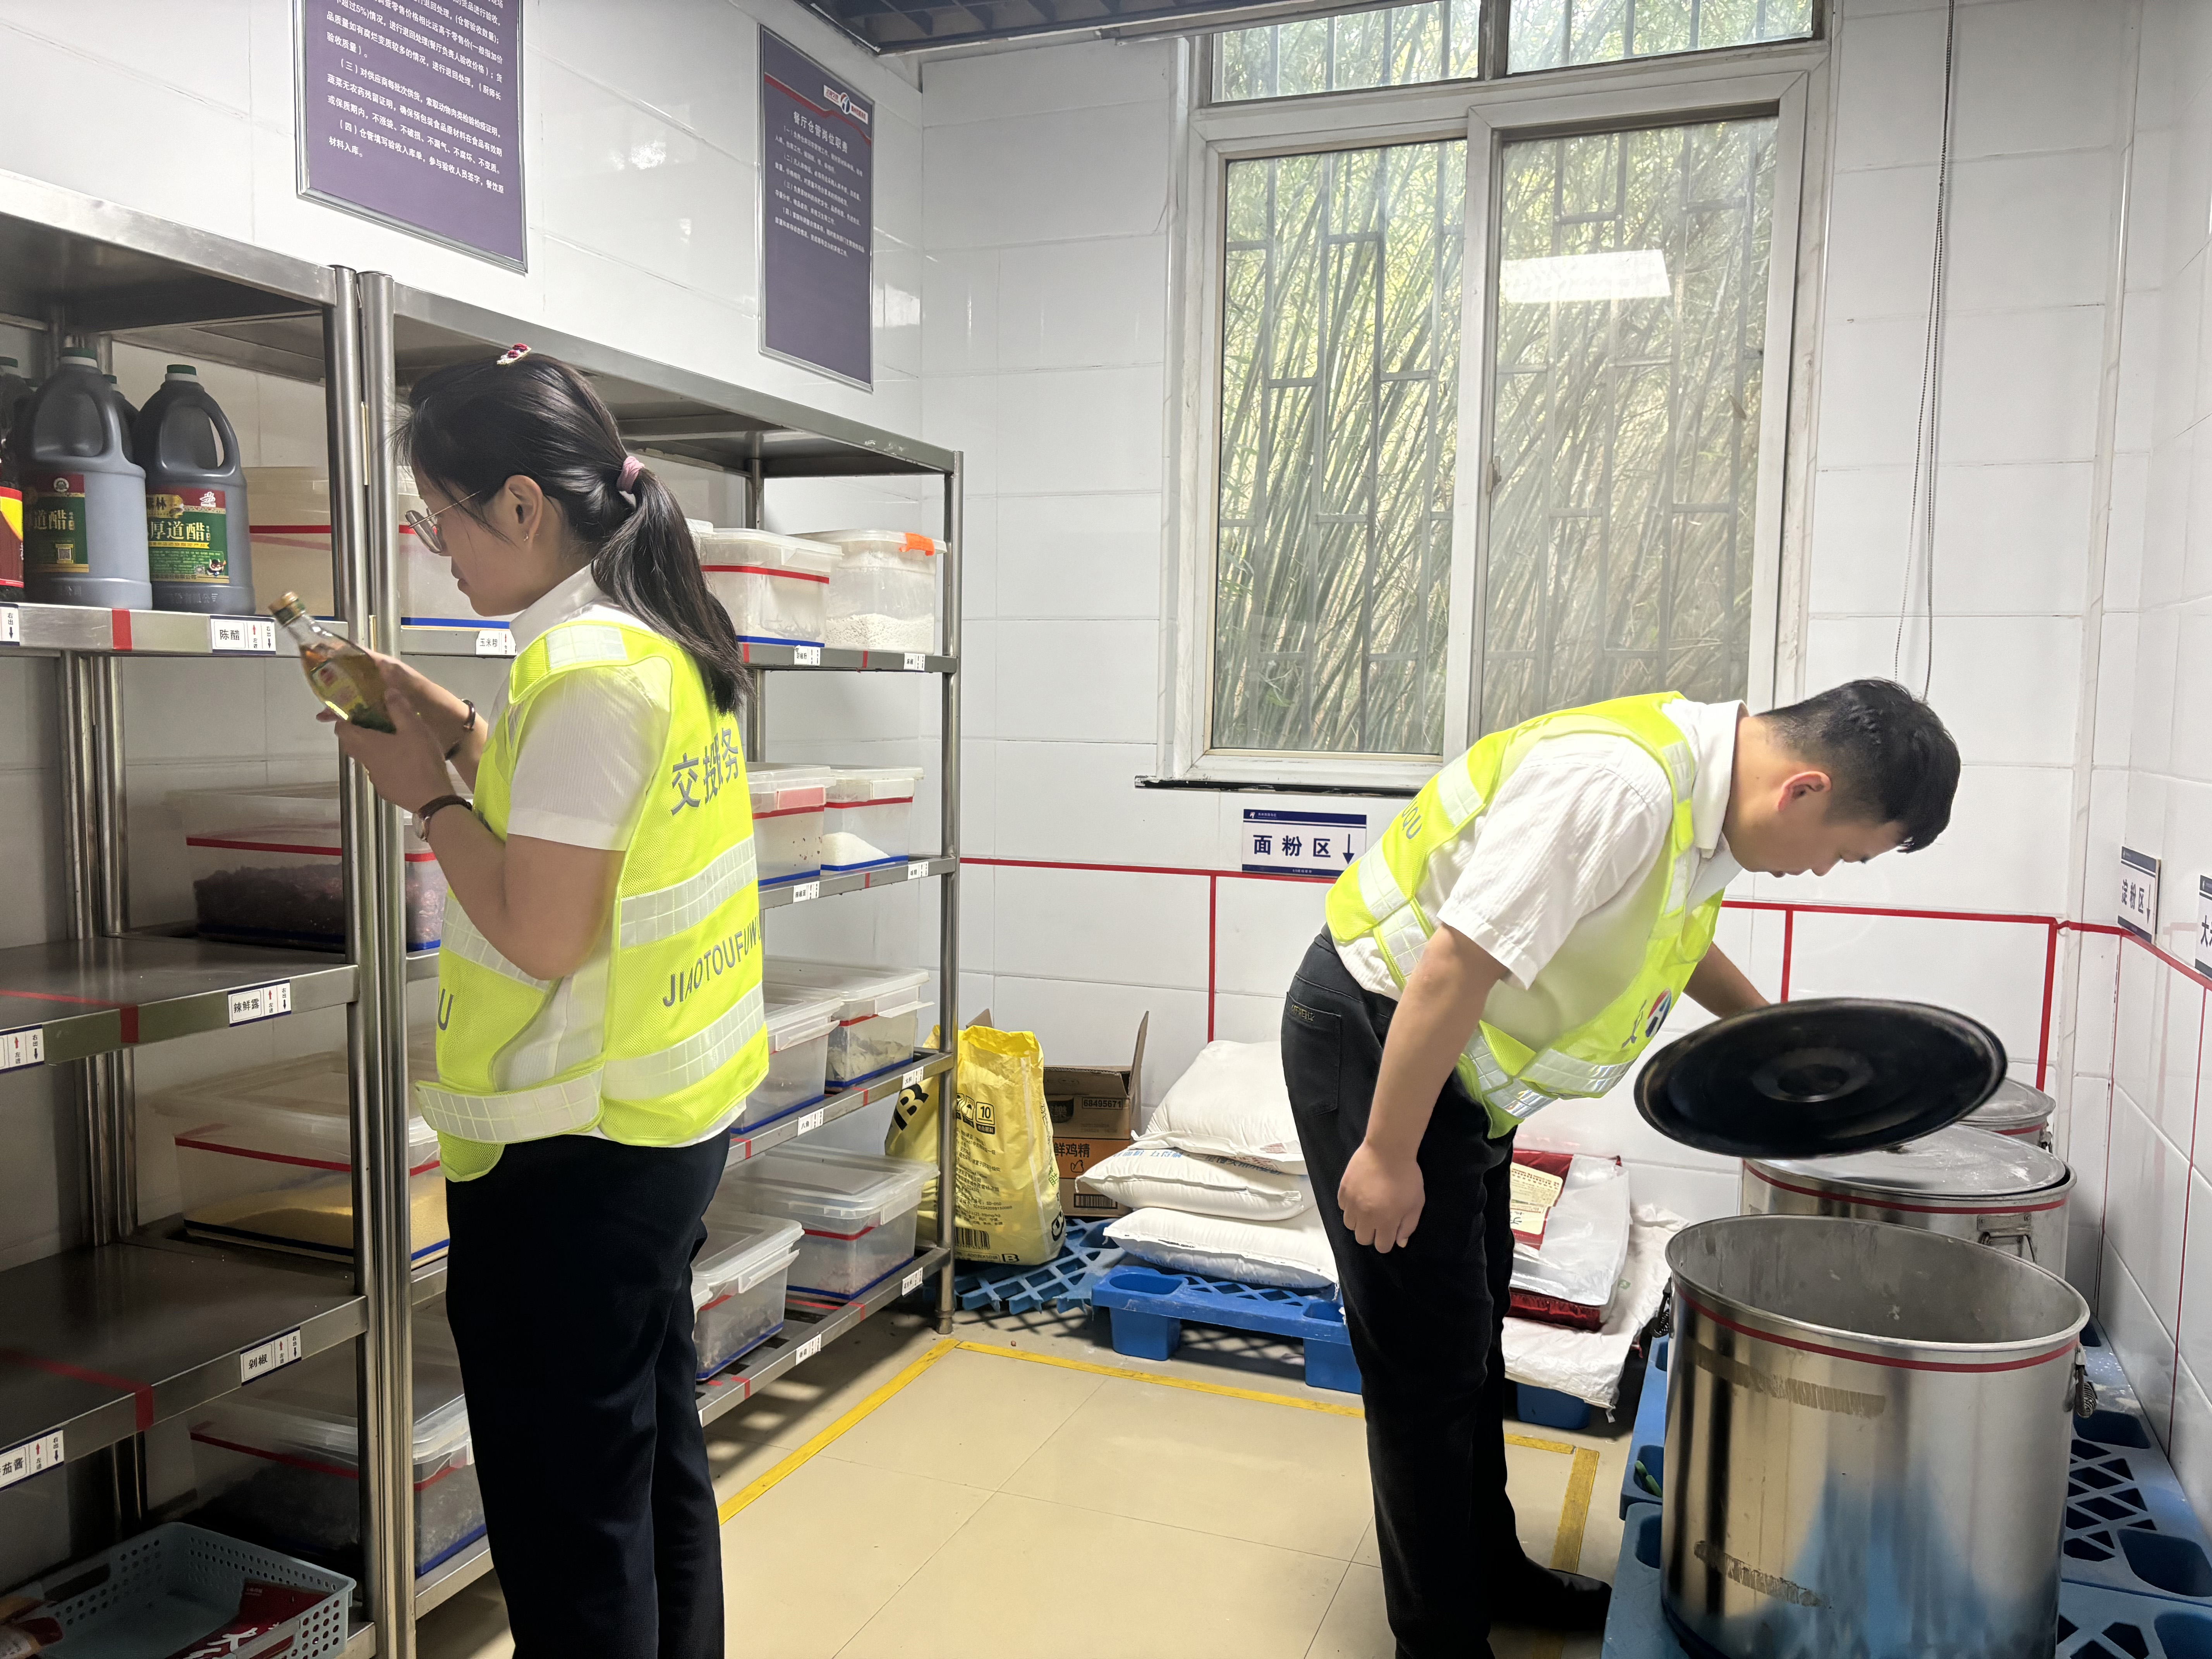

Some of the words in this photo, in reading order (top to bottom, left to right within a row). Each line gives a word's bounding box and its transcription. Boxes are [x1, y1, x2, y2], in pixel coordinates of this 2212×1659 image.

[793, 111, 847, 153] 餐厅仓管岗位职责
[328, 136, 363, 157] 材料入库。
[150, 520, 205, 541] 厚道醋
[220, 629, 240, 640] 陈醋
[1253, 834, 1331, 858] 面粉区
[234, 998, 259, 1013] 辣鲜露
[1084, 1099, 1122, 1108] 68495671
[980, 1106, 991, 1119] 10
[1054, 1142, 1090, 1158] 鲜鸡精
[1001, 1254, 1020, 1262] B
[248, 1354, 268, 1370] 剁椒
[0, 1457, 24, 1475] 茄酱
